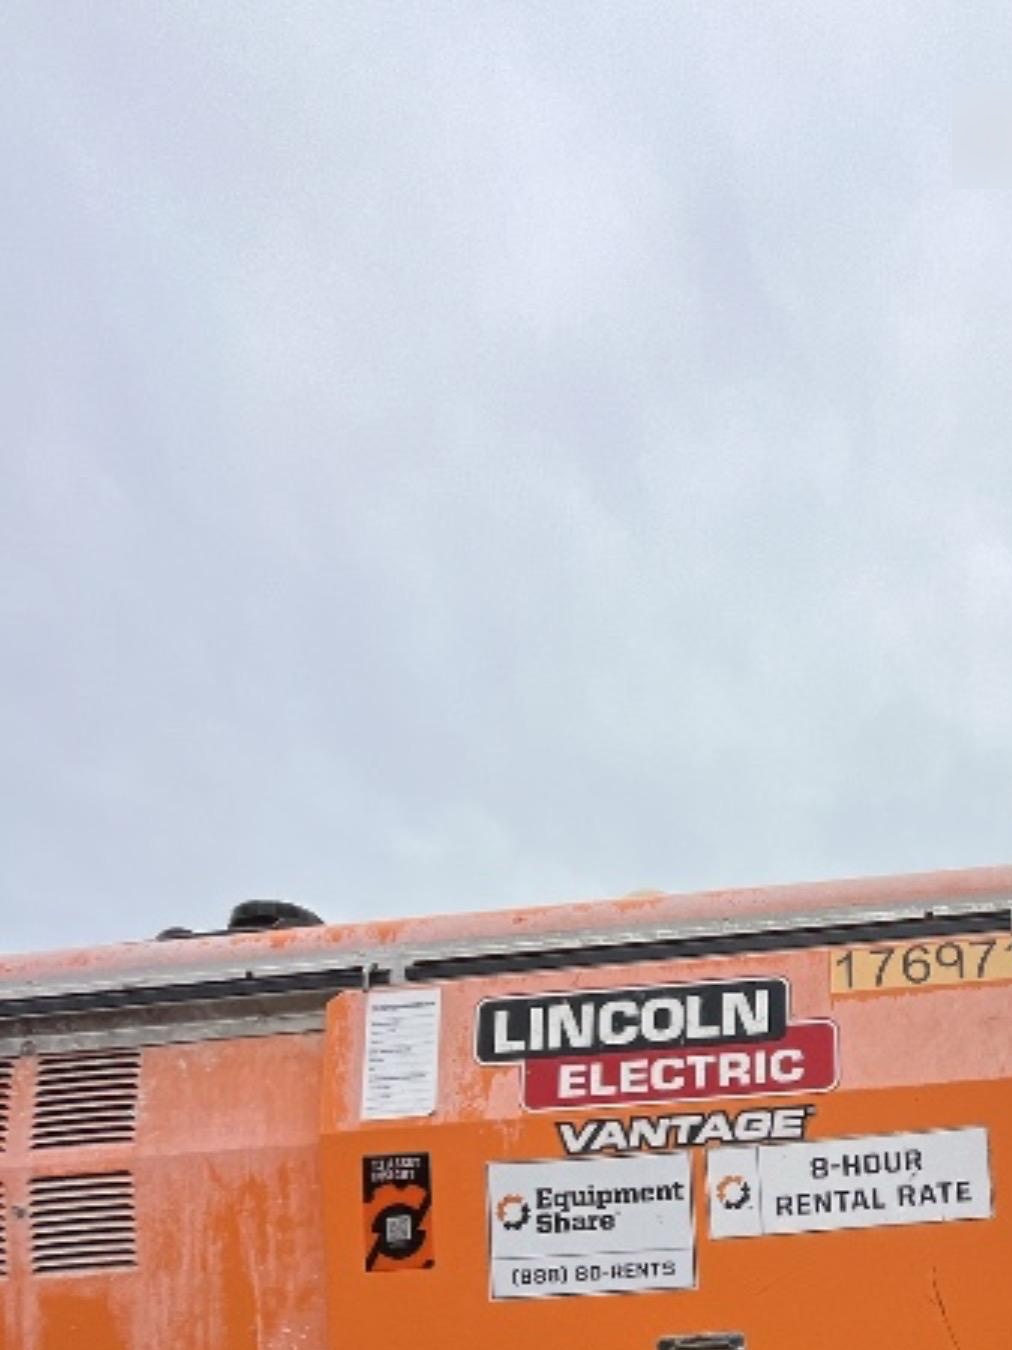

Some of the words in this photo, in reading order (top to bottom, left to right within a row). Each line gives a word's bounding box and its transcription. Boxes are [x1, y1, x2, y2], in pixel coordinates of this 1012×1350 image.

[493, 989, 769, 1054] LINCOLN
[557, 1048, 805, 1099] ELECTRIC
[556, 1106, 806, 1154] VANTAGE
[810, 1148, 923, 1180] 8-HOUR
[535, 1181, 685, 1212] Equipment
[775, 1186, 886, 1216] RENTAL
[897, 1180, 974, 1208] RATE
[536, 1211, 616, 1234] Share
